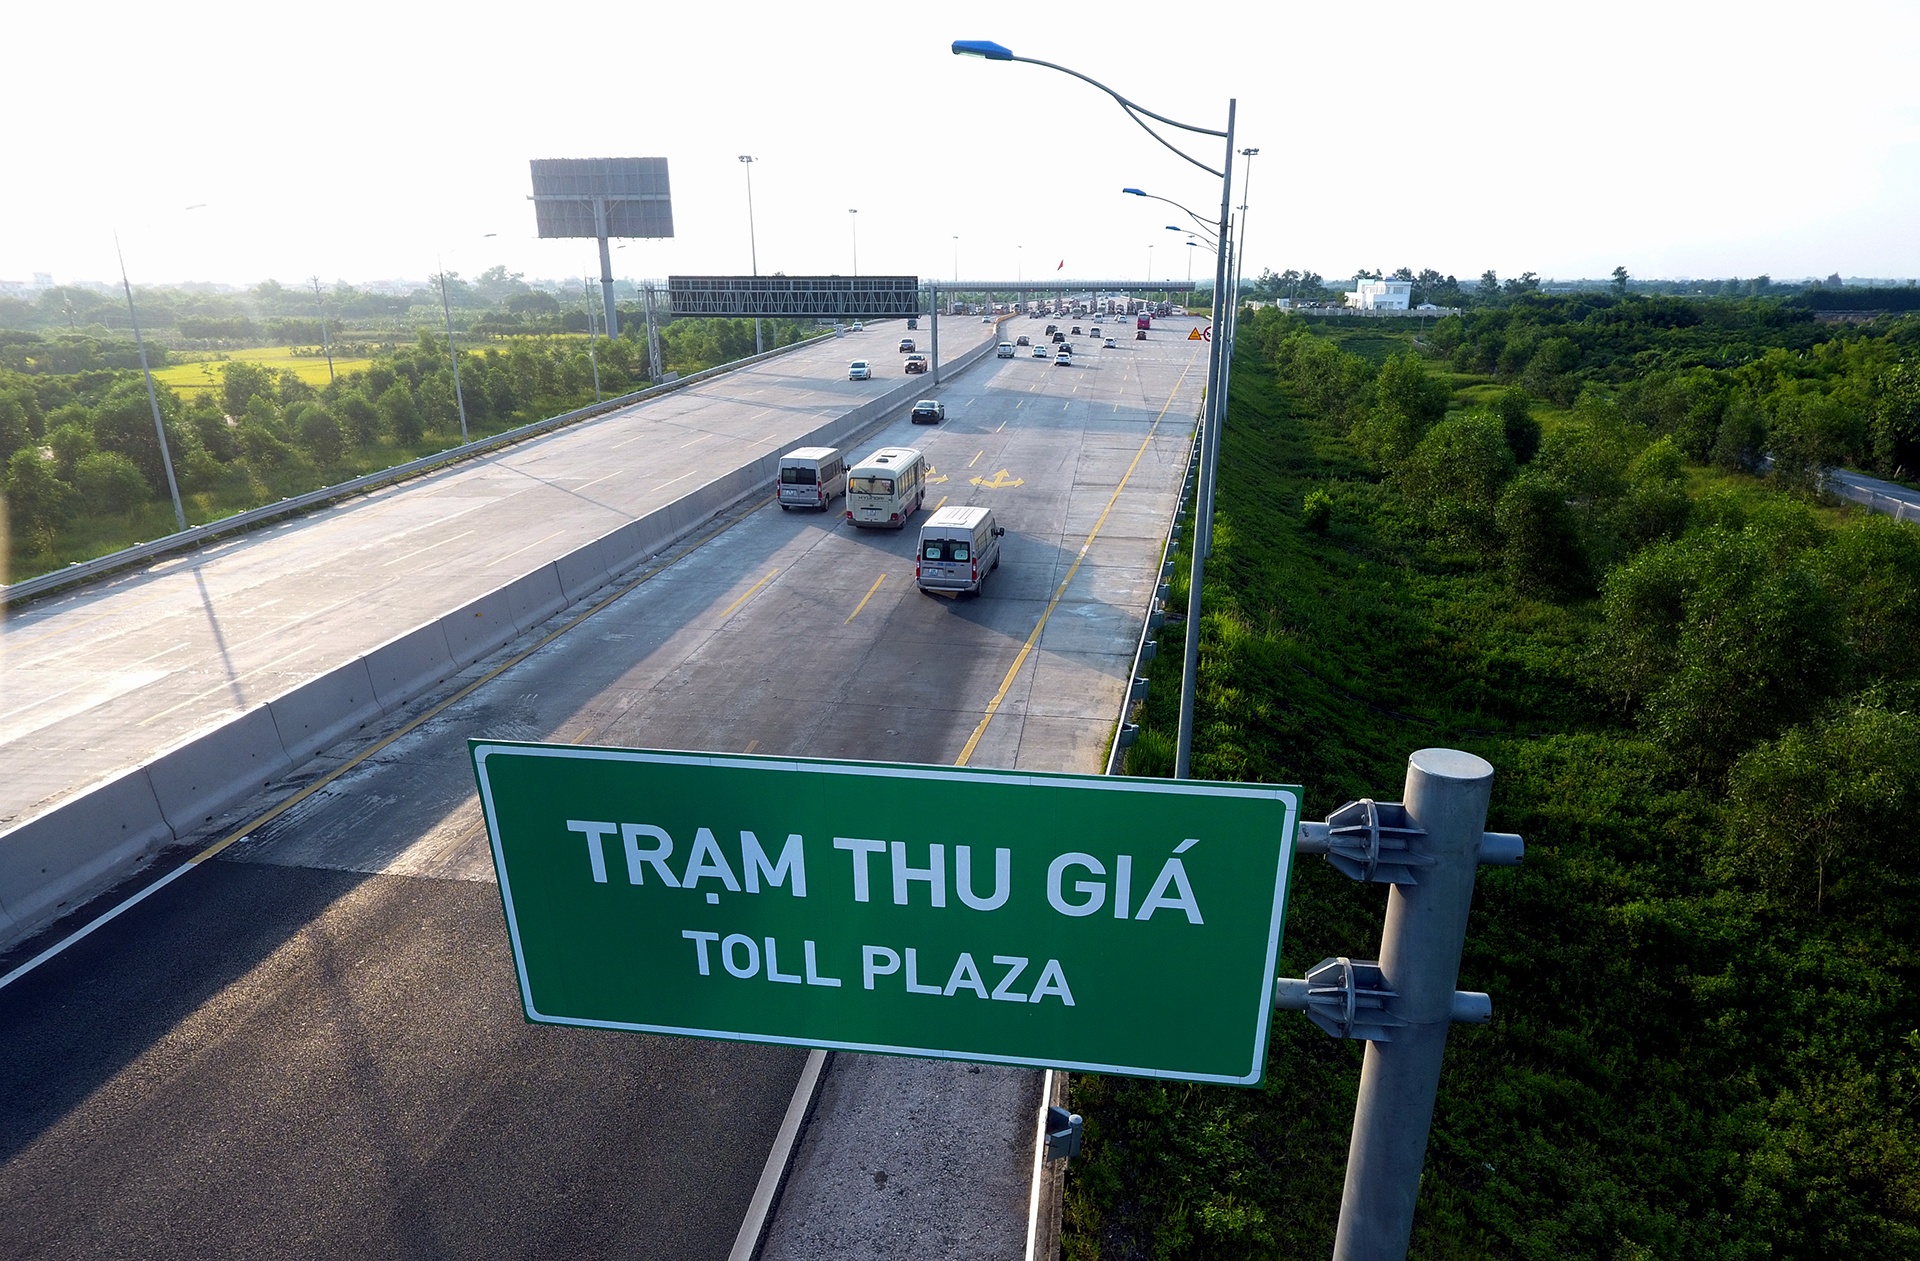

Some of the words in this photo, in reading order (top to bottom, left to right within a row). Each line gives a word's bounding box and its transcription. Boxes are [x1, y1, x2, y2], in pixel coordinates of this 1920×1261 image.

[566, 819, 808, 907] TRẠM
[833, 837, 1011, 911] THU
[1046, 838, 1205, 925] GIÁ
[681, 929, 842, 988] TOLL
[862, 944, 1076, 1007] PLAZA
